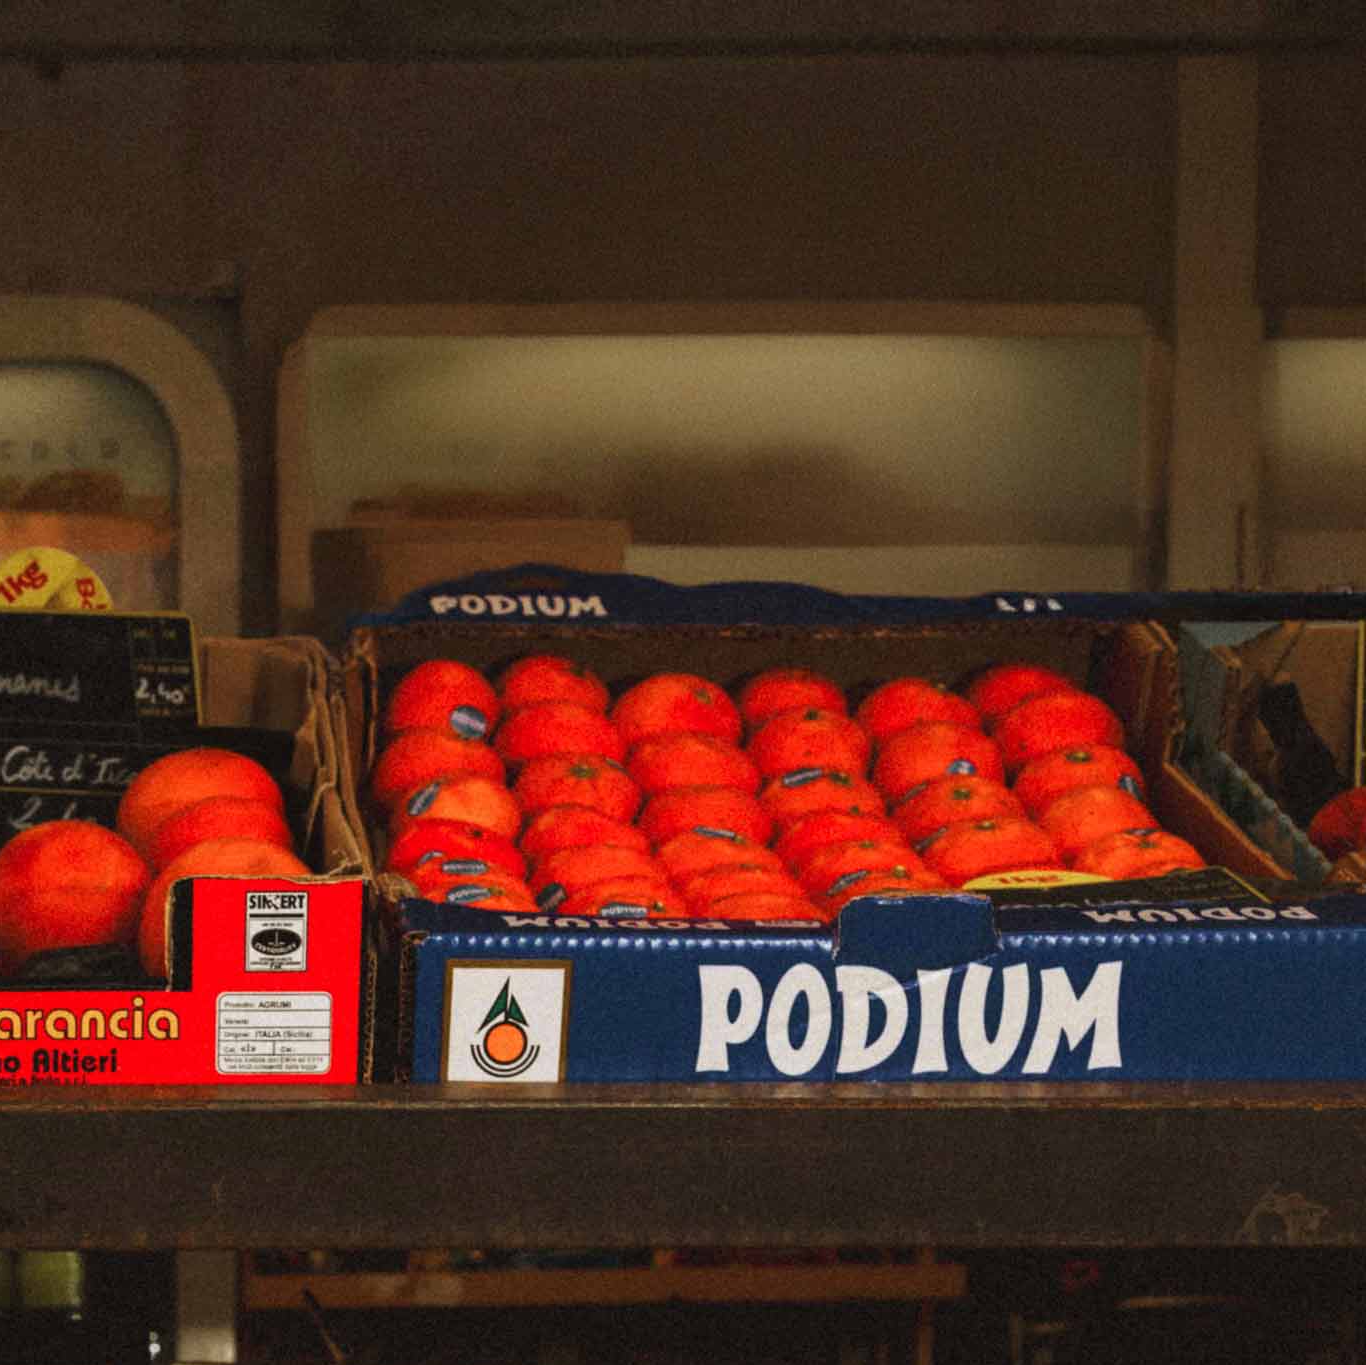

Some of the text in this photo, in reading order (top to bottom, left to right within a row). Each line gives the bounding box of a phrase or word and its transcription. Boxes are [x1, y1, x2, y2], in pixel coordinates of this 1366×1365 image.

[429, 594, 609, 618] PODIUM
[502, 915, 731, 930] PODIUM
[1082, 906, 1319, 923] PODIUM
[694, 960, 1124, 1076] PODIUM
[255, 1030, 282, 1039] ITALIA
[32, 1047, 118, 1073] Altieri
